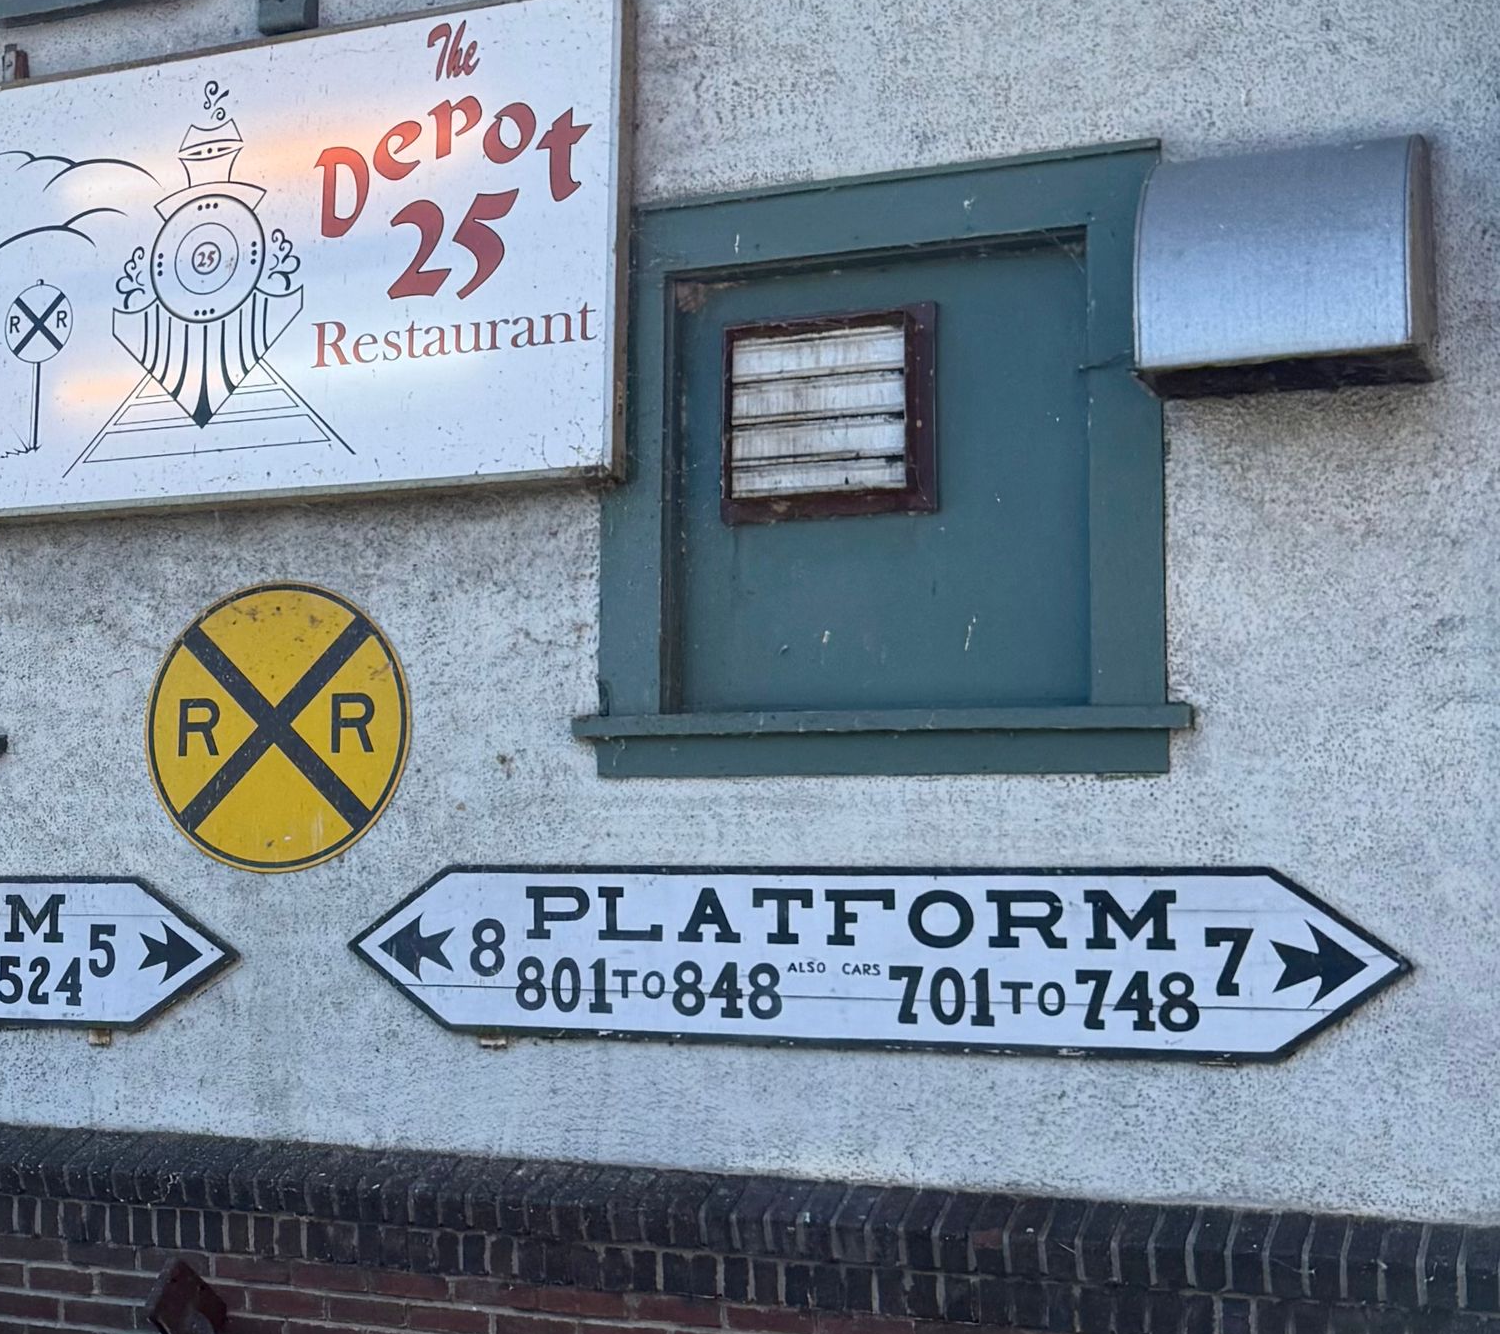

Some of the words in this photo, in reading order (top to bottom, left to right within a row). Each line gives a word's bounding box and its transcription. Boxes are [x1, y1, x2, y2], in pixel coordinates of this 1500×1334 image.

[426, 19, 481, 82] The
[194, 249, 216, 269] 25
[387, 188, 519, 300] 25
[8, 315, 20, 334] R
[55, 308, 68, 328] R
[311, 301, 598, 368] Restaurant
[177, 700, 220, 758] R
[332, 698, 373, 755] R
[469, 917, 506, 977] 8
[525, 885, 1177, 951] PLATFORM
[0, 956, 84, 1006] 524
[88, 924, 118, 978] 5
[787, 961, 828, 975] ALSO
[841, 961, 883, 977] CARS
[1203, 926, 1255, 997] 7
[515, 955, 614, 1014] 801
[671, 960, 784, 1021] 848
[888, 965, 996, 1027] 701
[1075, 968, 1201, 1033] 748
